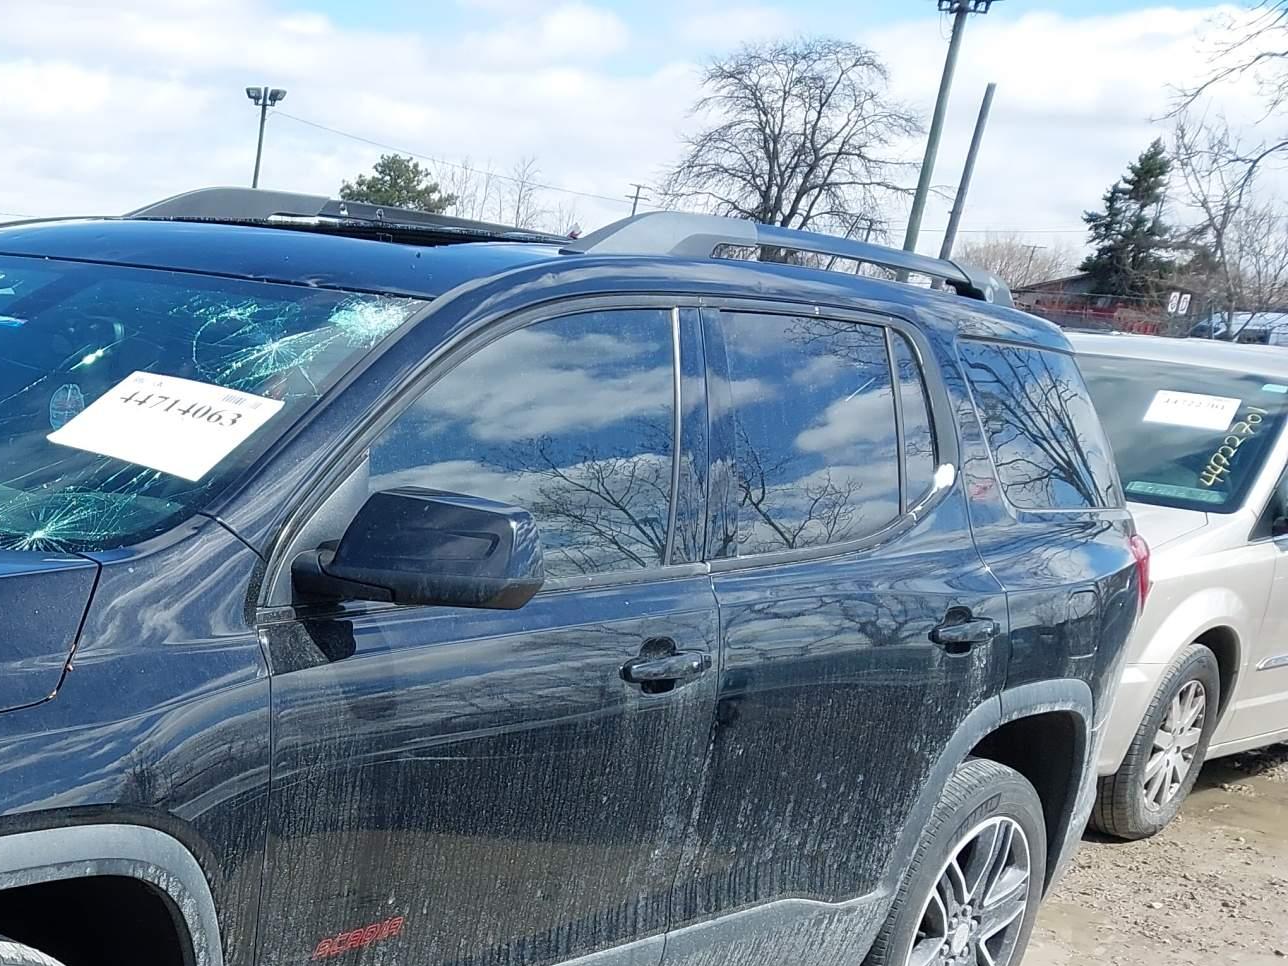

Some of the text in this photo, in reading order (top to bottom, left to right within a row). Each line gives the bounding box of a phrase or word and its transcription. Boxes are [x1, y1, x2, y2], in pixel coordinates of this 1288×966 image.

[119, 390, 243, 427] 44714063
[1199, 405, 1269, 486] 44922701
[311, 915, 404, 961] ACADIA
